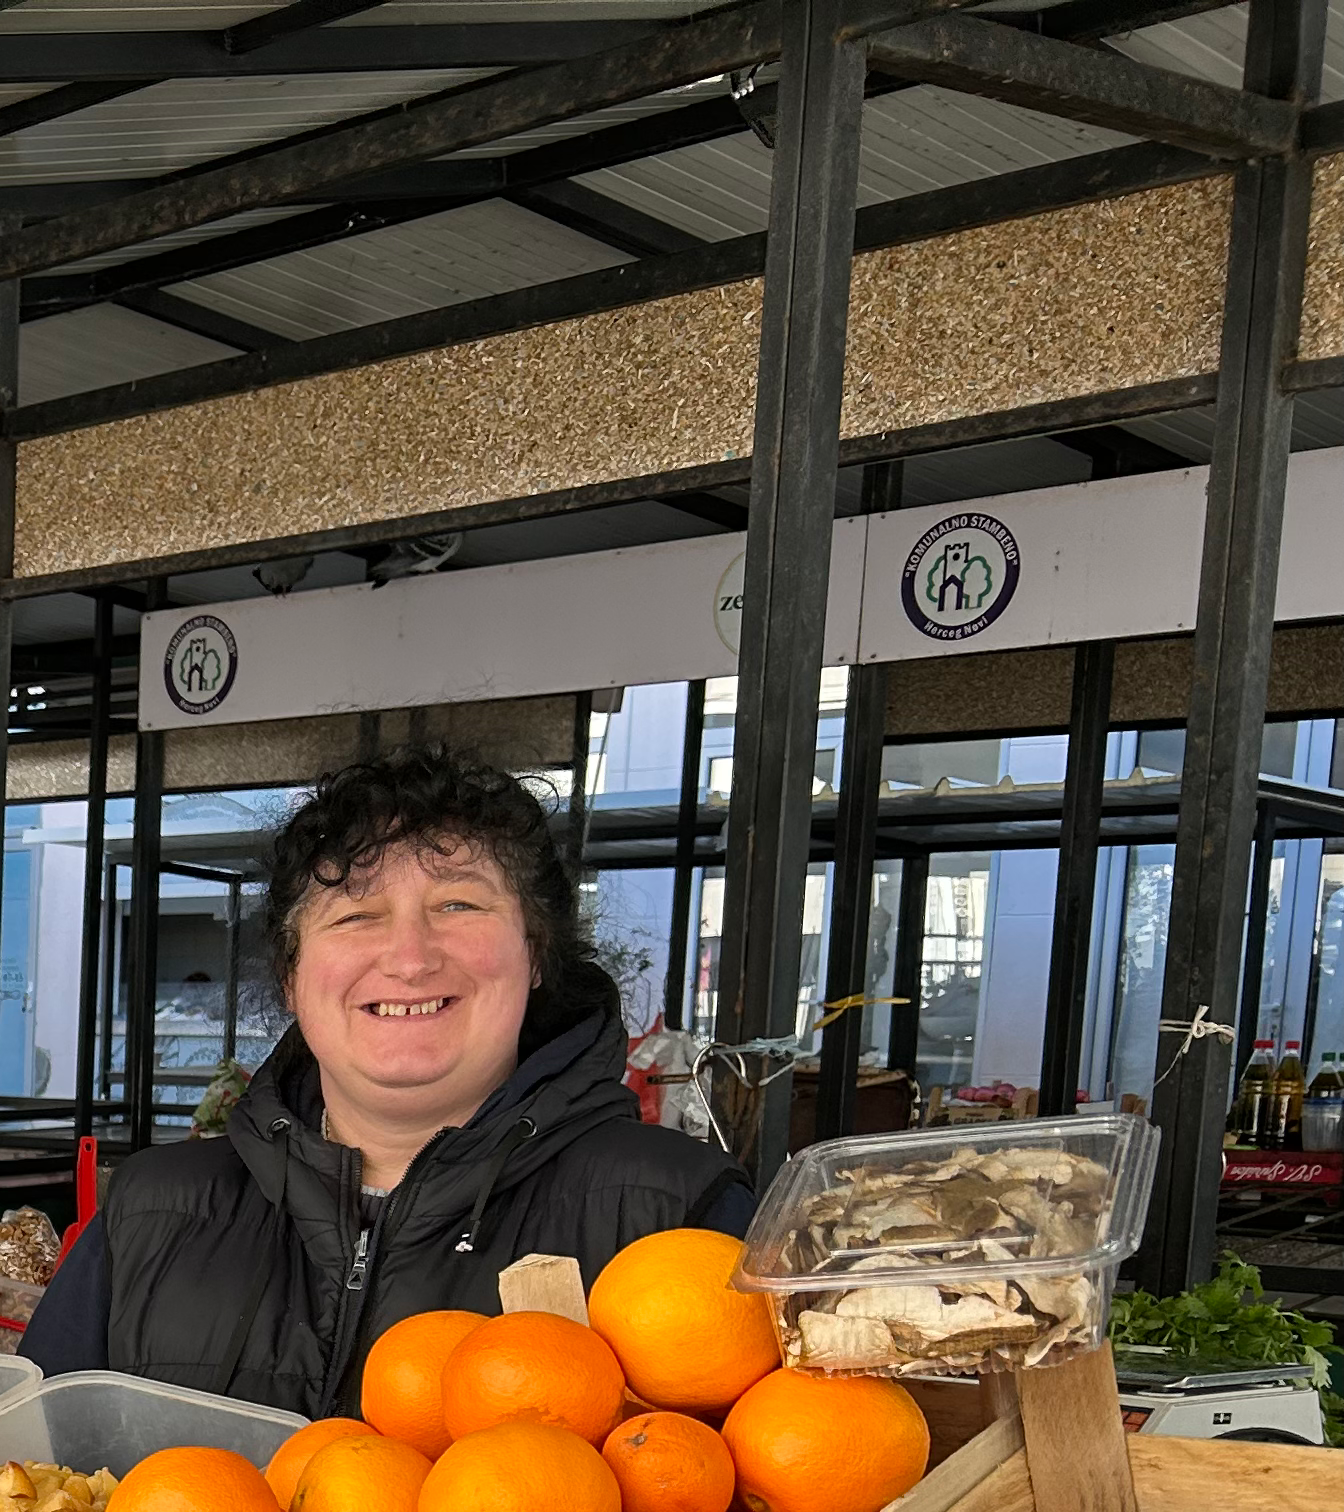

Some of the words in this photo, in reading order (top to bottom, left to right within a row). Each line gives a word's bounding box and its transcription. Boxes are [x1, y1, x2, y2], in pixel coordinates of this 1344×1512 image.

[720, 594, 744, 611] ze
[923, 620, 962, 640] Herceg
[963, 615, 989, 636] Novi
